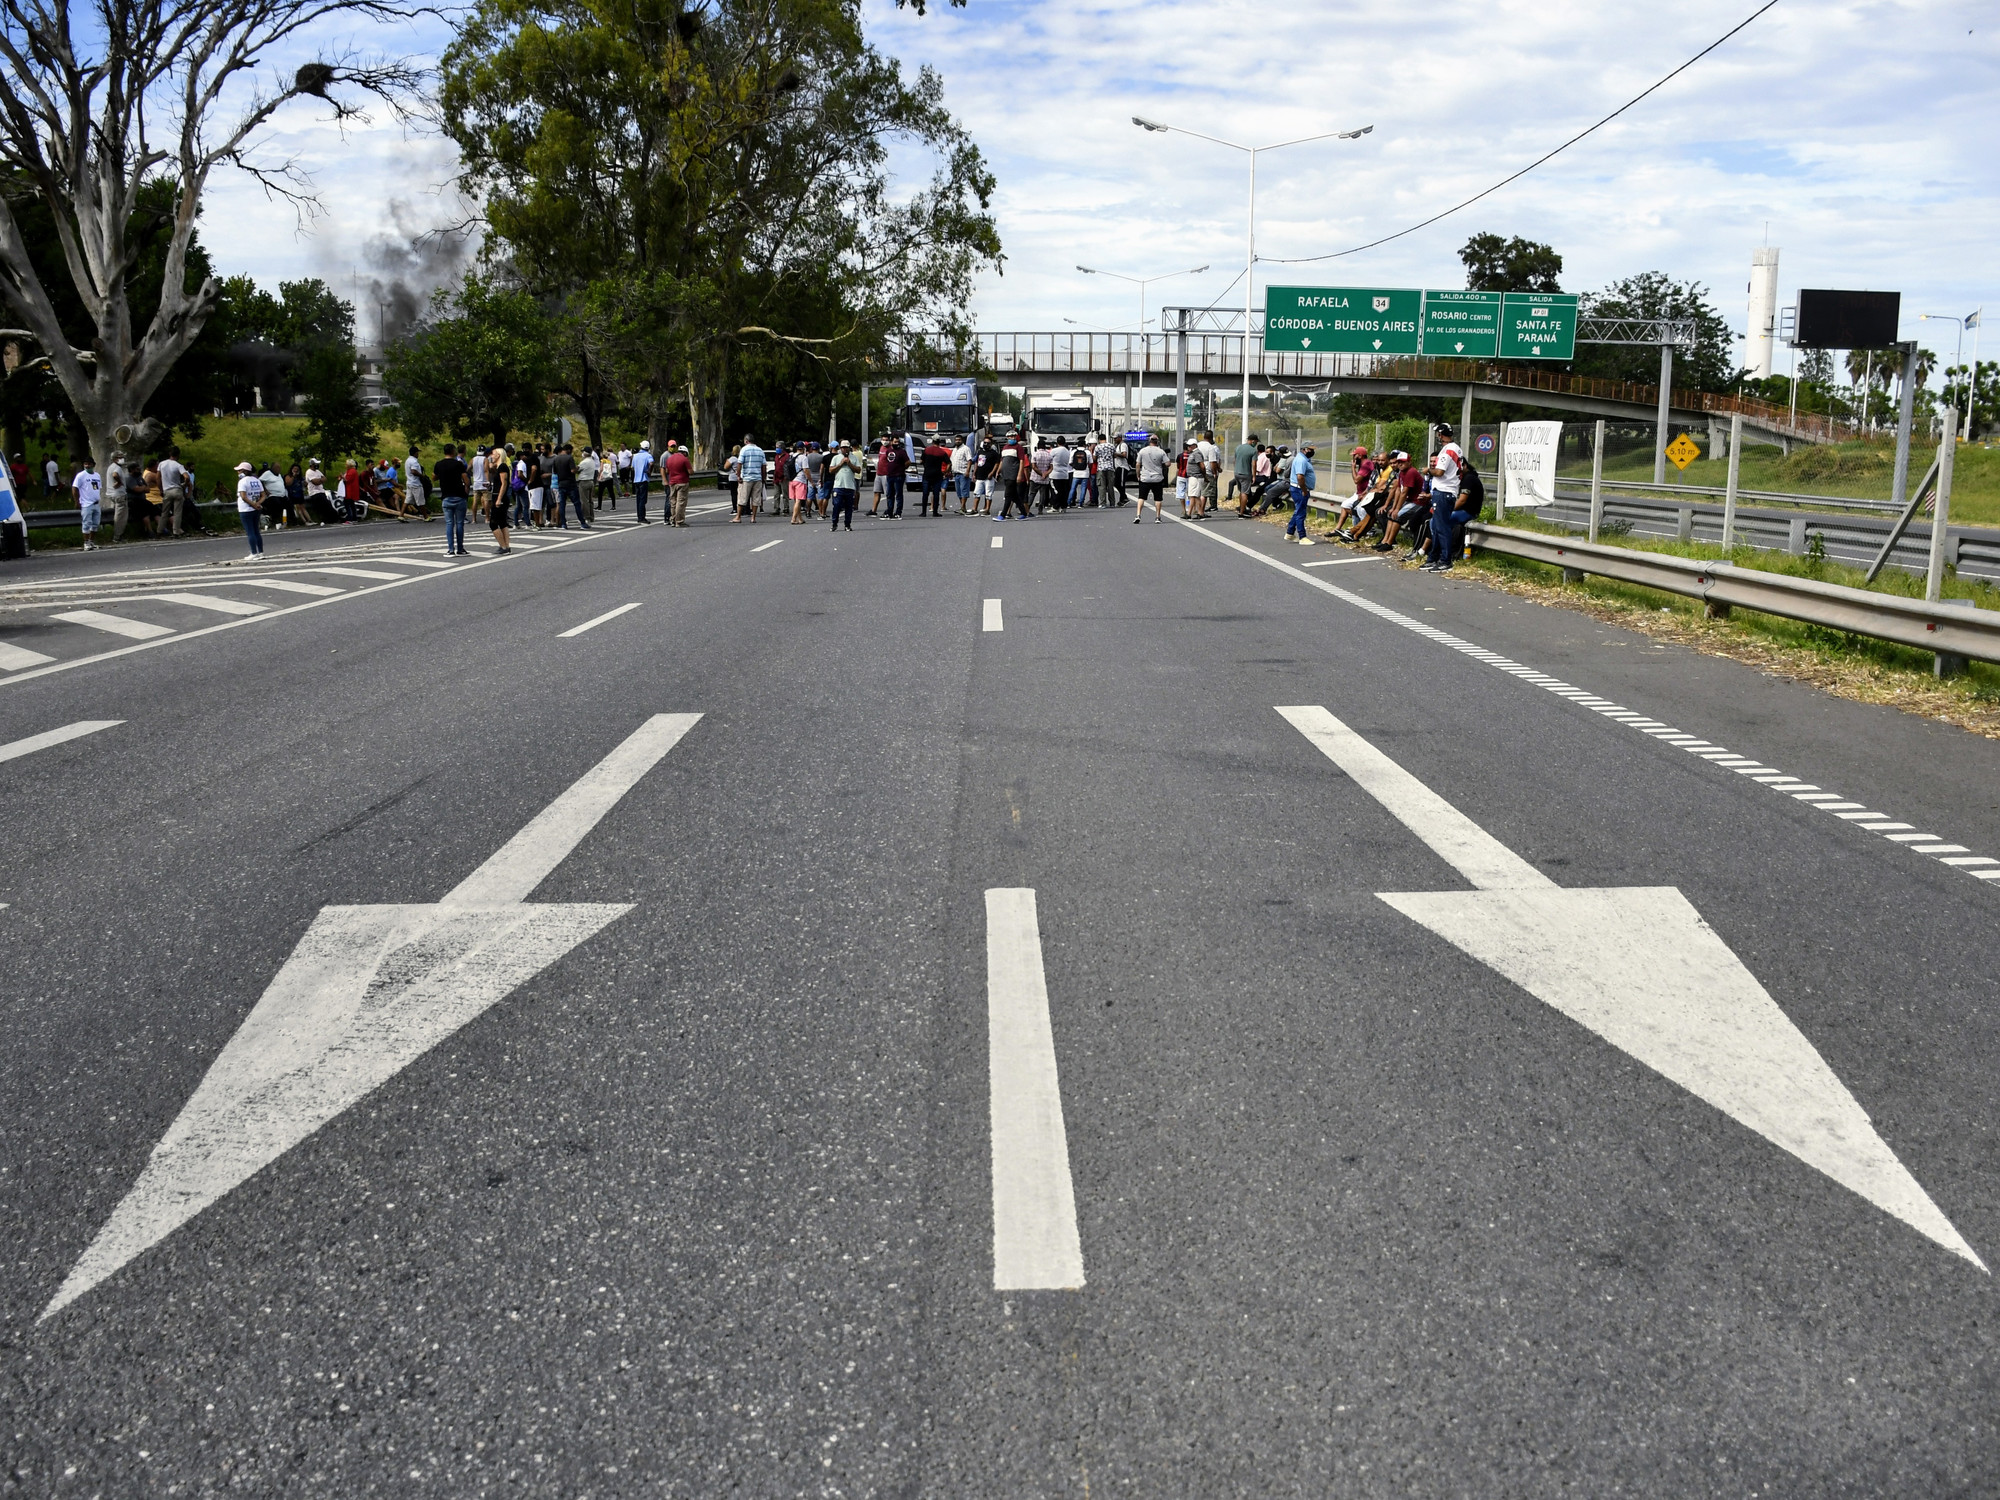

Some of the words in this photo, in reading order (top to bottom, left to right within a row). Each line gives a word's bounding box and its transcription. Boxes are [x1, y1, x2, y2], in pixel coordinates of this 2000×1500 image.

[1298, 296, 1349, 308] RAFAELA
[1375, 299, 1386, 308] 34
[1431, 311, 1468, 321] ROSARIO
[1270, 316, 1324, 330] CÓRDOBA
[1334, 320, 1379, 332] BUENOS
[1382, 321, 1415, 332] AIRES
[1515, 320, 1547, 331] SANTA
[1549, 321, 1562, 331] FE
[1517, 332, 1557, 343] PARANÁ
[1478, 439, 1492, 450] 60
